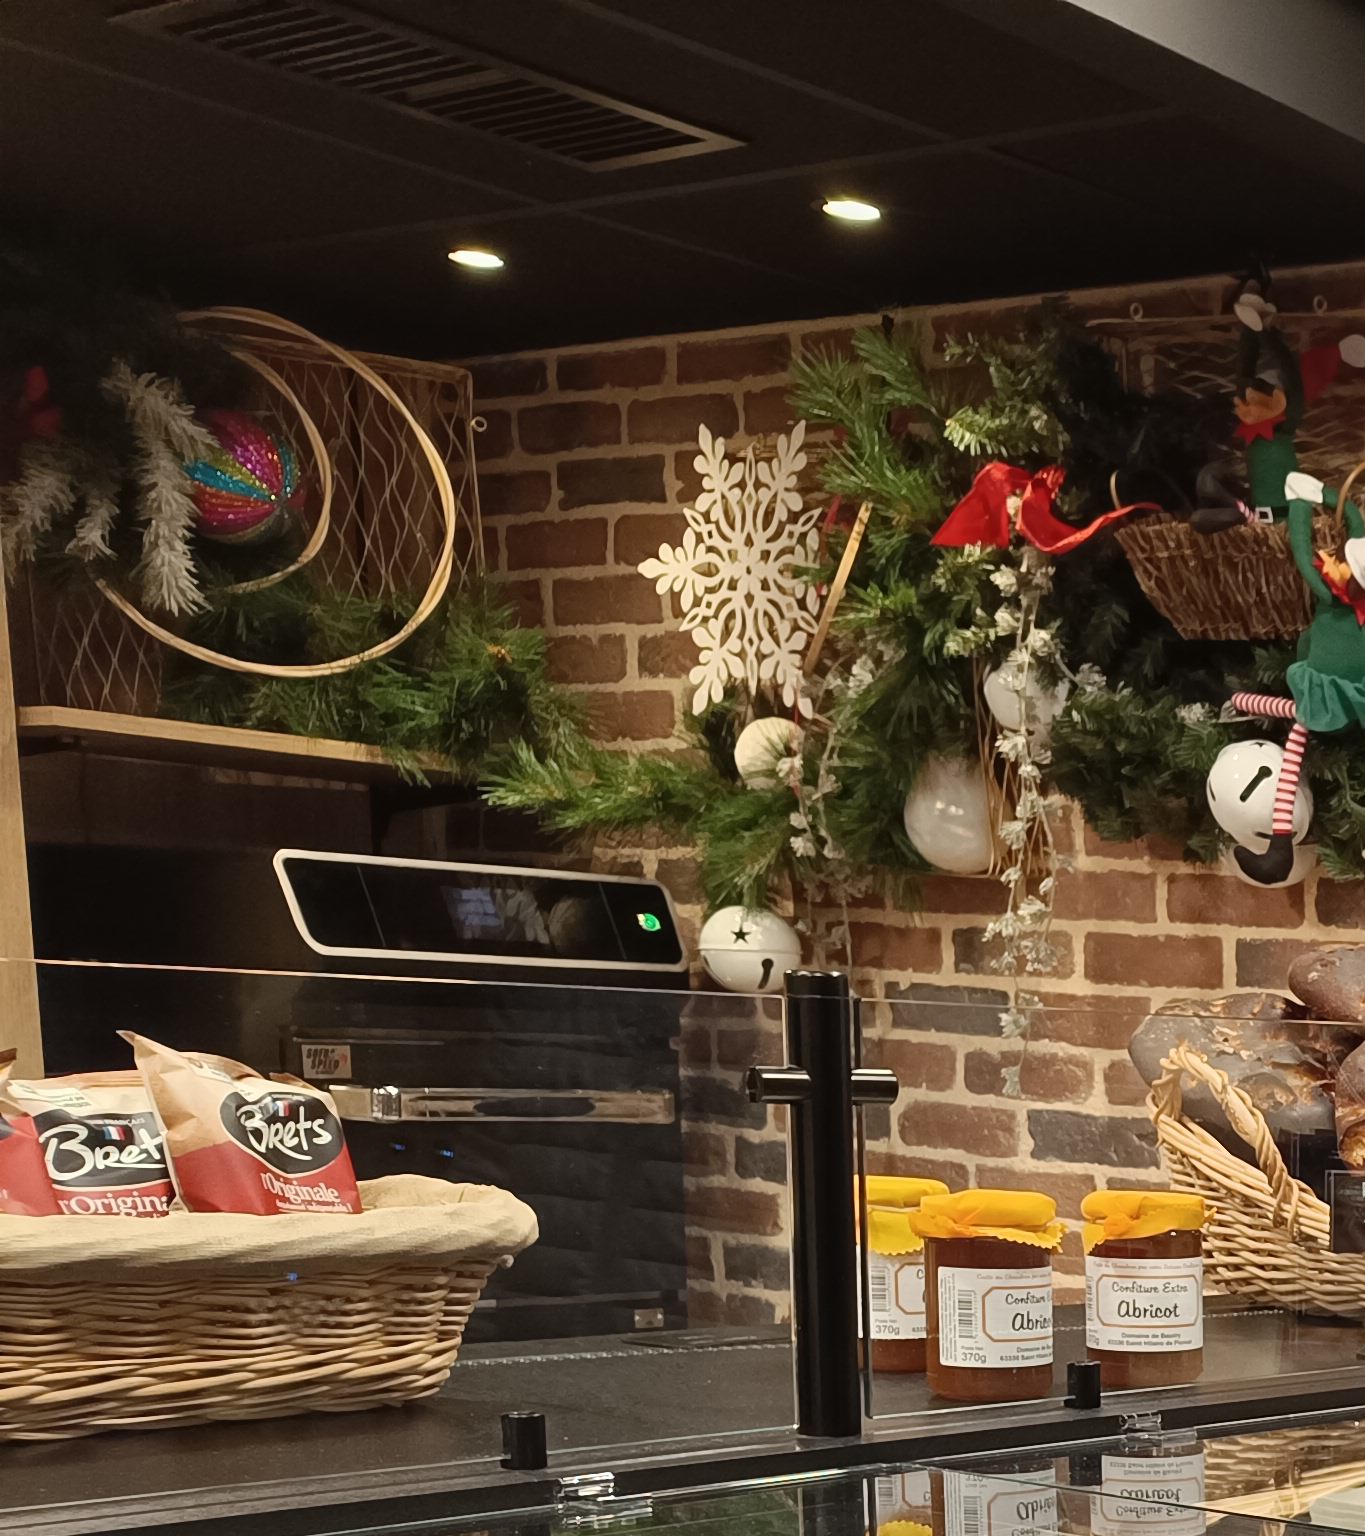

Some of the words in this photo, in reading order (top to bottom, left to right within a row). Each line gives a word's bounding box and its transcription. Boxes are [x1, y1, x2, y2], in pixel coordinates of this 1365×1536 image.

[236, 1095, 333, 1161] Brets
[38, 1123, 167, 1181] Bret
[1112, 1281, 1159, 1294] Confiture
[1117, 1298, 1180, 1319] Abricot
[961, 1352, 987, 1364] 370g
